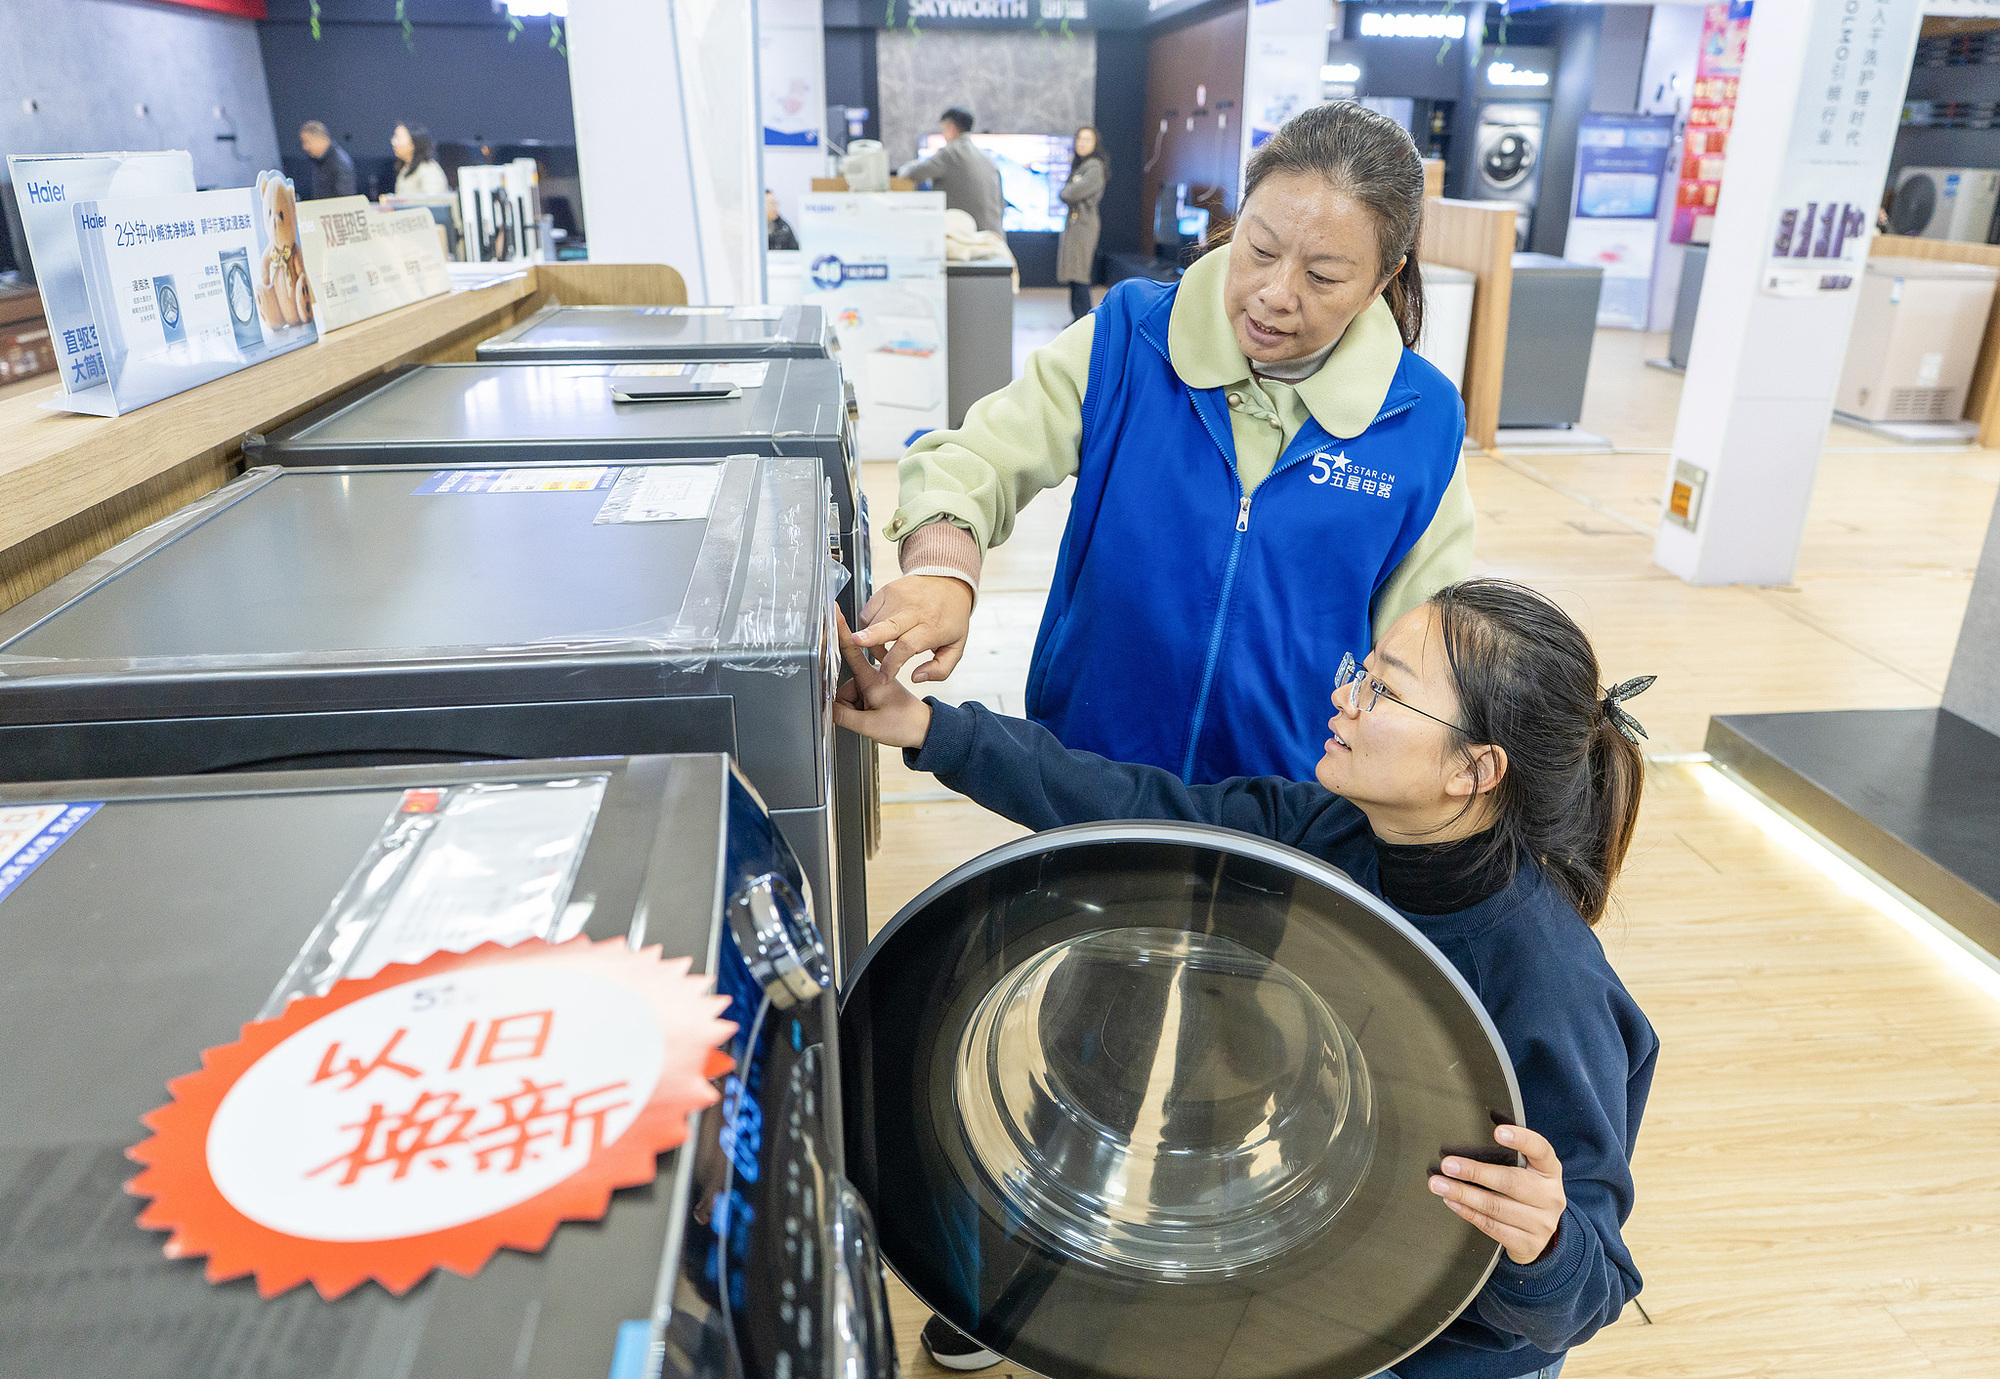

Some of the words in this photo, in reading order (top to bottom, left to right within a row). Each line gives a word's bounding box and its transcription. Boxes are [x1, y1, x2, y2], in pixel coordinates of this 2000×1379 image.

[909, 0, 1028, 18] SKYWORTH
[27, 180, 66, 204] Haier
[81, 213, 108, 230] Haier
[1308, 452, 1334, 484] 5
[1346, 464, 1395, 483] 5STAR.CN
[1329, 471, 1393, 499] 五星电器
[308, 1009, 553, 1092] 以旧
[302, 1077, 631, 1187] 换新
